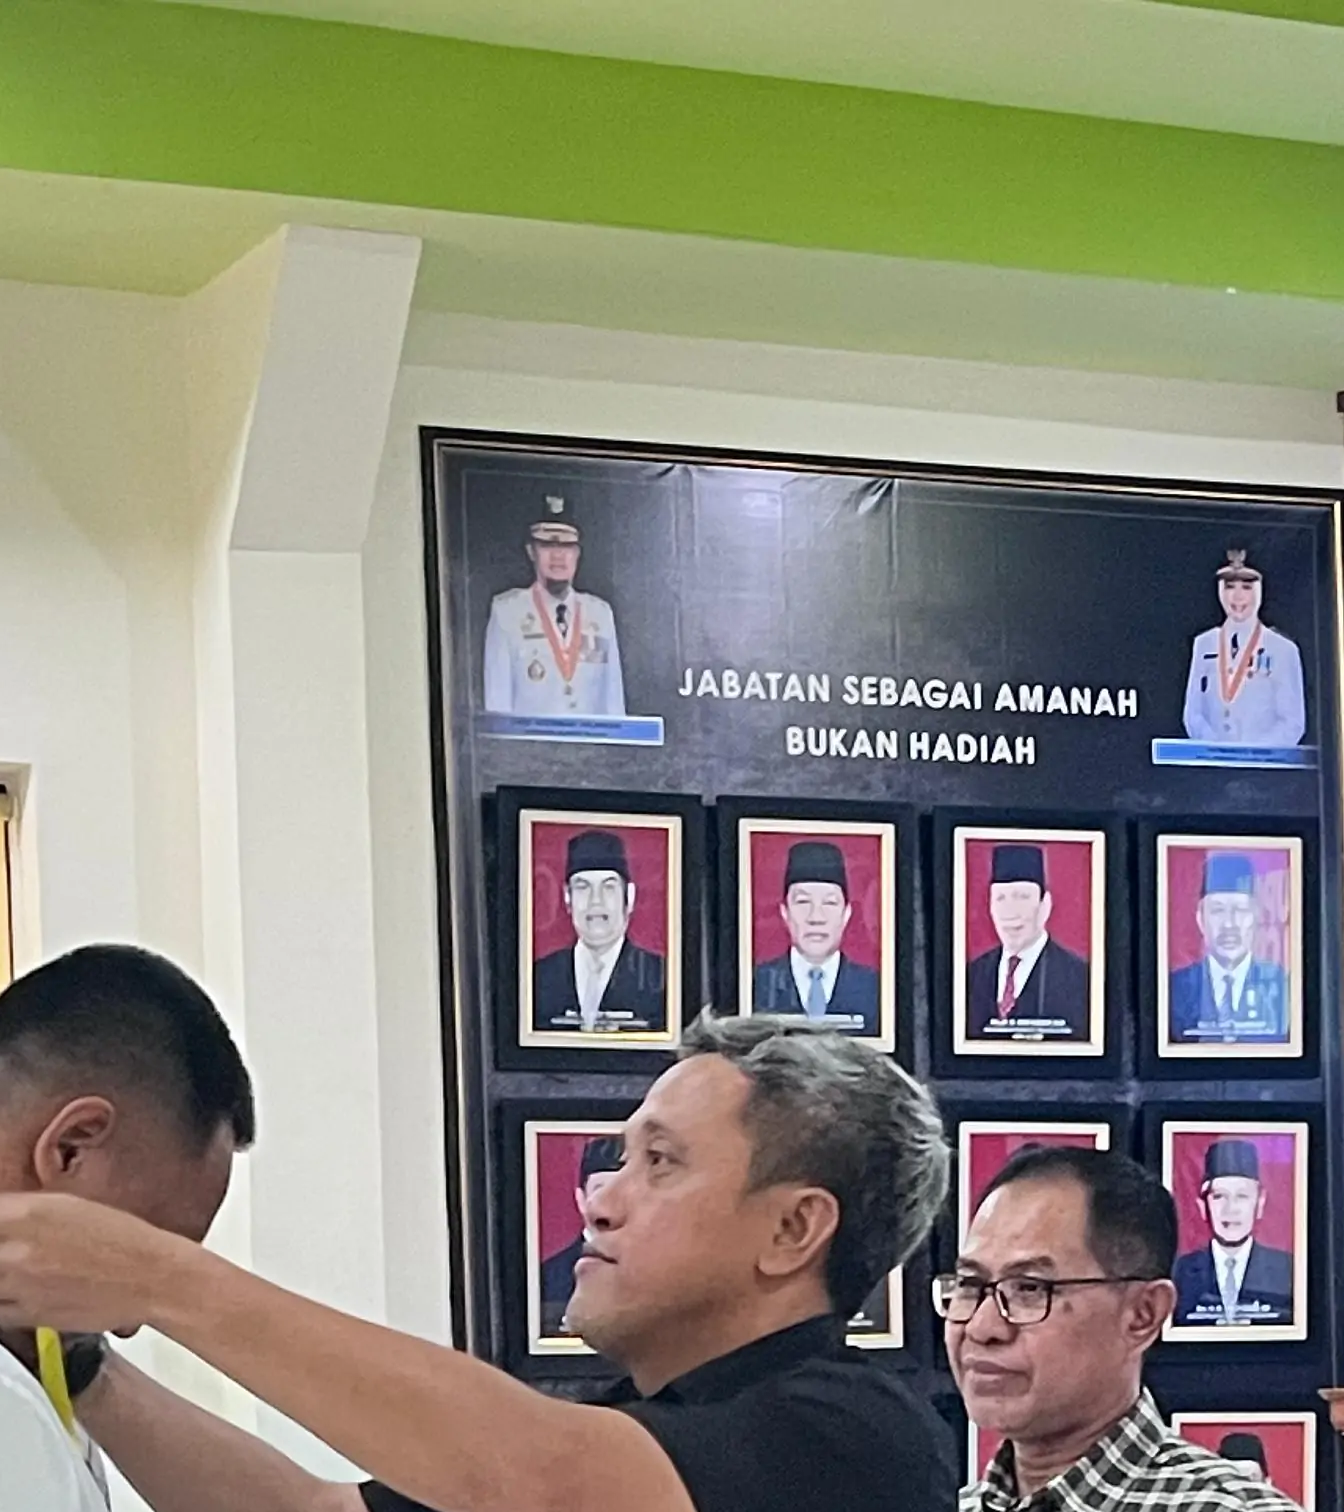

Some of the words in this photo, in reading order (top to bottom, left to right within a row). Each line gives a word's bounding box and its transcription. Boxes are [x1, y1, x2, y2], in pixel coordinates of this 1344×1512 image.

[678, 667, 831, 703] JABATAN
[842, 675, 983, 711] SEBAGAI
[994, 683, 1139, 718] AMANAH
[785, 725, 899, 760] BUKAN
[909, 731, 1036, 765] HADIAH
